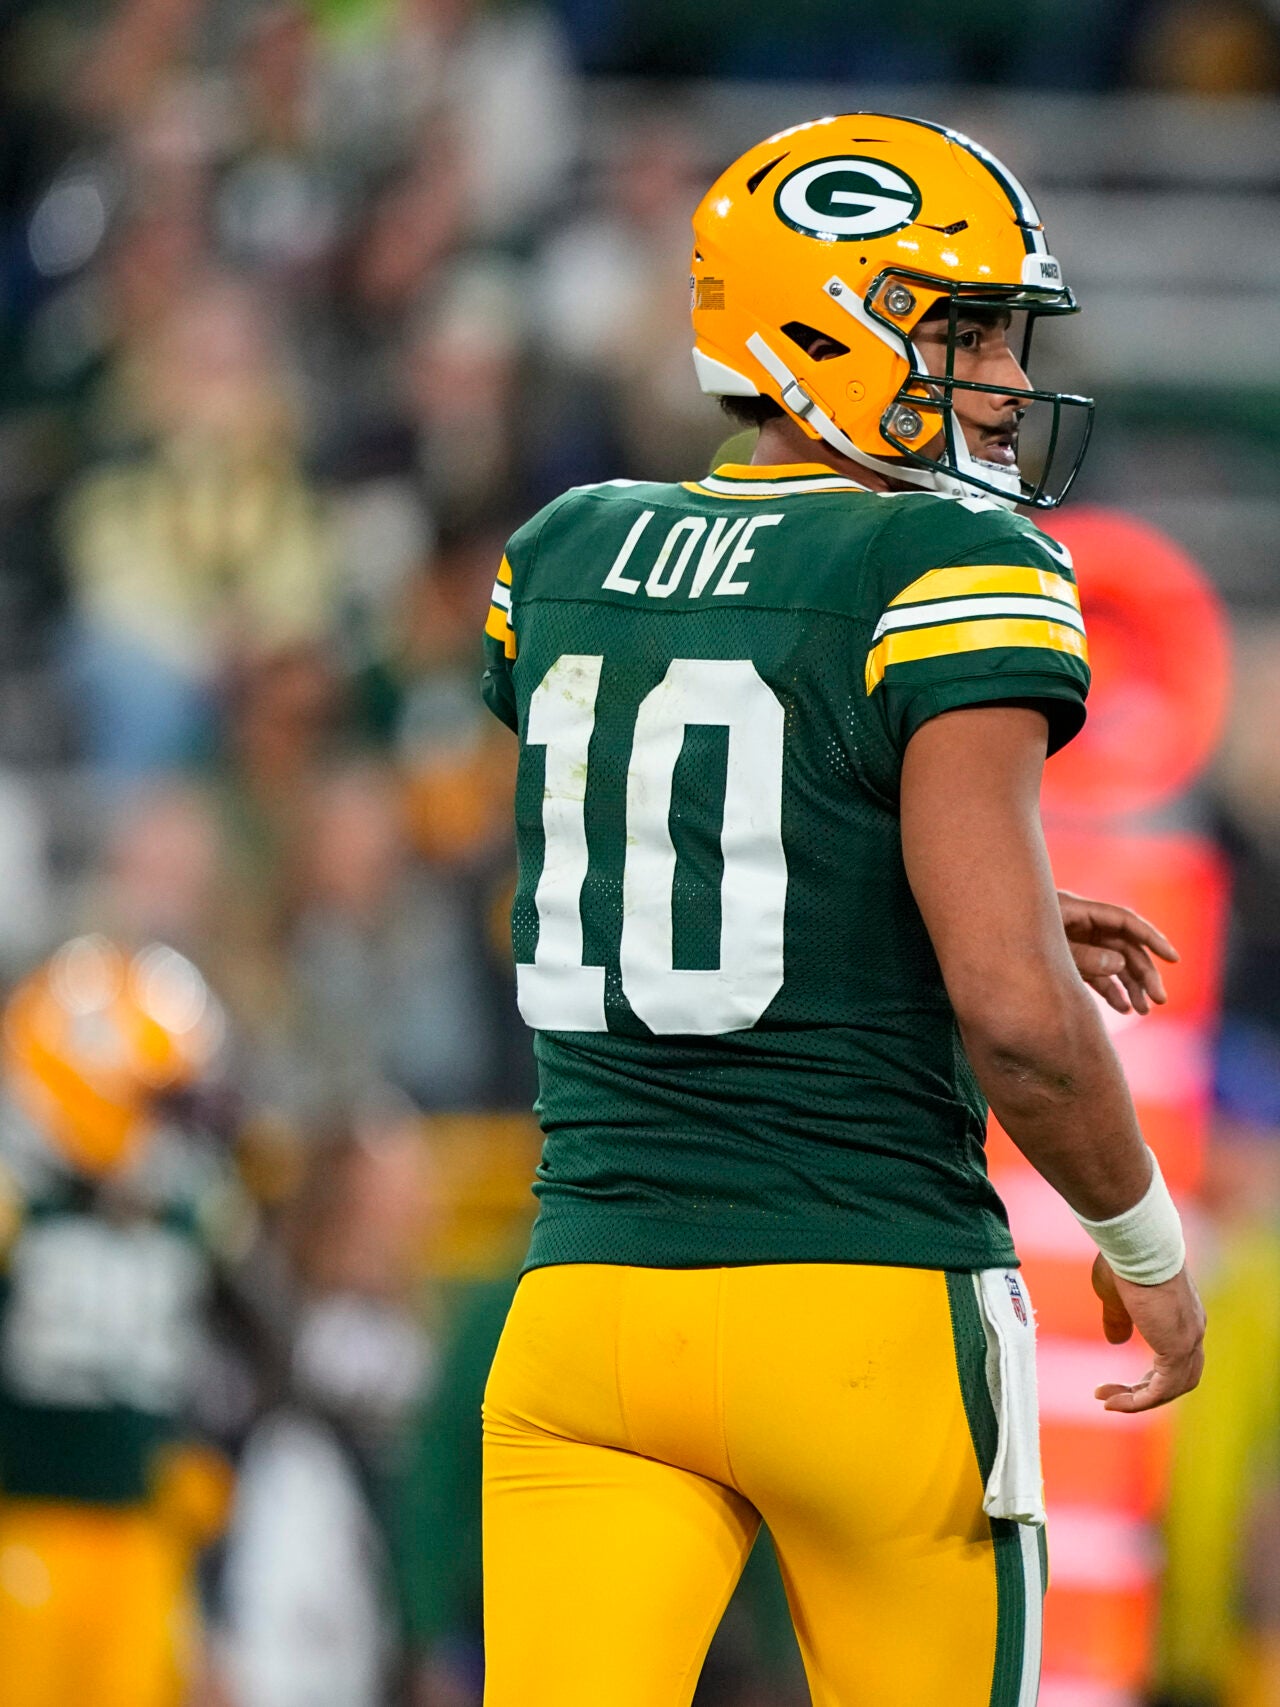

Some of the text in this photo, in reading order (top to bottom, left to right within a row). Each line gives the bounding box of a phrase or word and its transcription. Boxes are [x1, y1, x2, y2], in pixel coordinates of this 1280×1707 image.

[779, 159, 916, 236] G
[602, 510, 784, 598] LOVE
[516, 655, 788, 1035] 10
